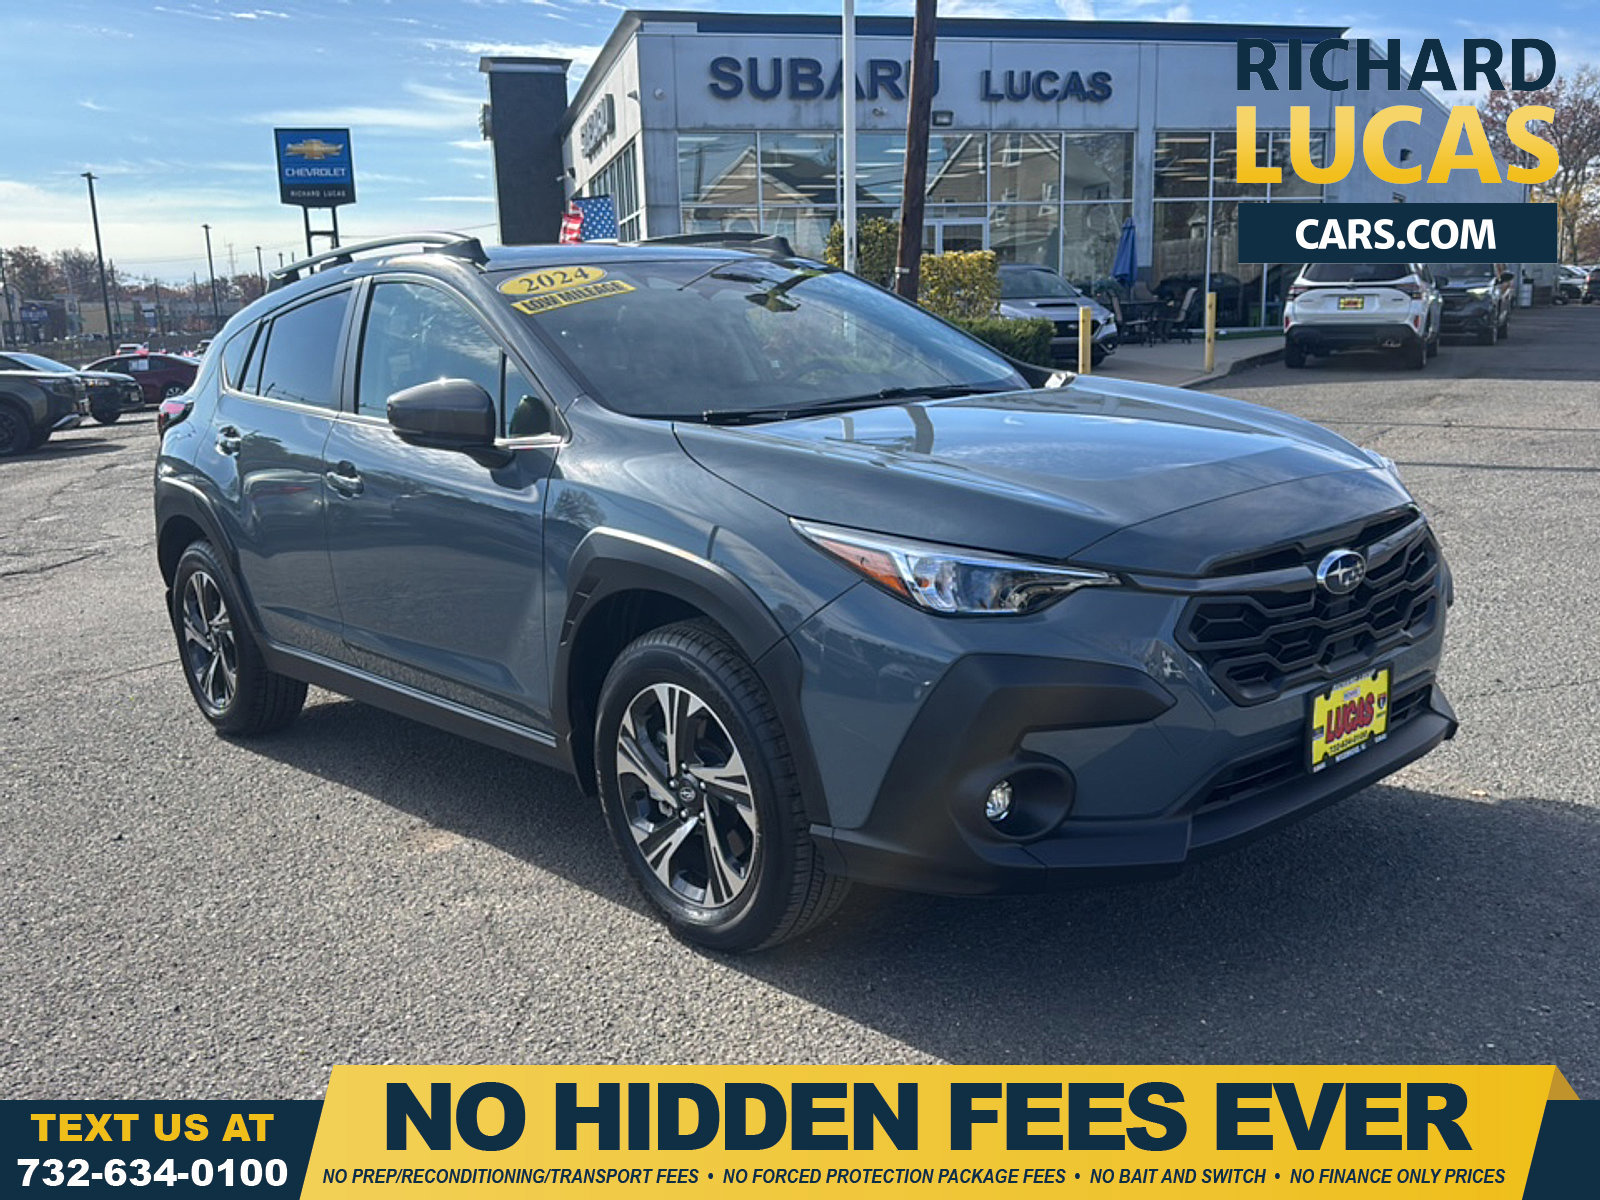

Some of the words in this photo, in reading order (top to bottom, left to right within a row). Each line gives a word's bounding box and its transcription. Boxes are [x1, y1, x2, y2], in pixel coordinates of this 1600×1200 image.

[981, 69, 1113, 102] LUCAS
[285, 166, 346, 177] CHEVROLET
[289, 189, 321, 198] RICHARD
[323, 189, 347, 198] LUCAS
[519, 267, 589, 292] 2024
[521, 294, 558, 311] LOW
[559, 282, 623, 303] MILEAGE
[1326, 692, 1374, 744] LUCAS
